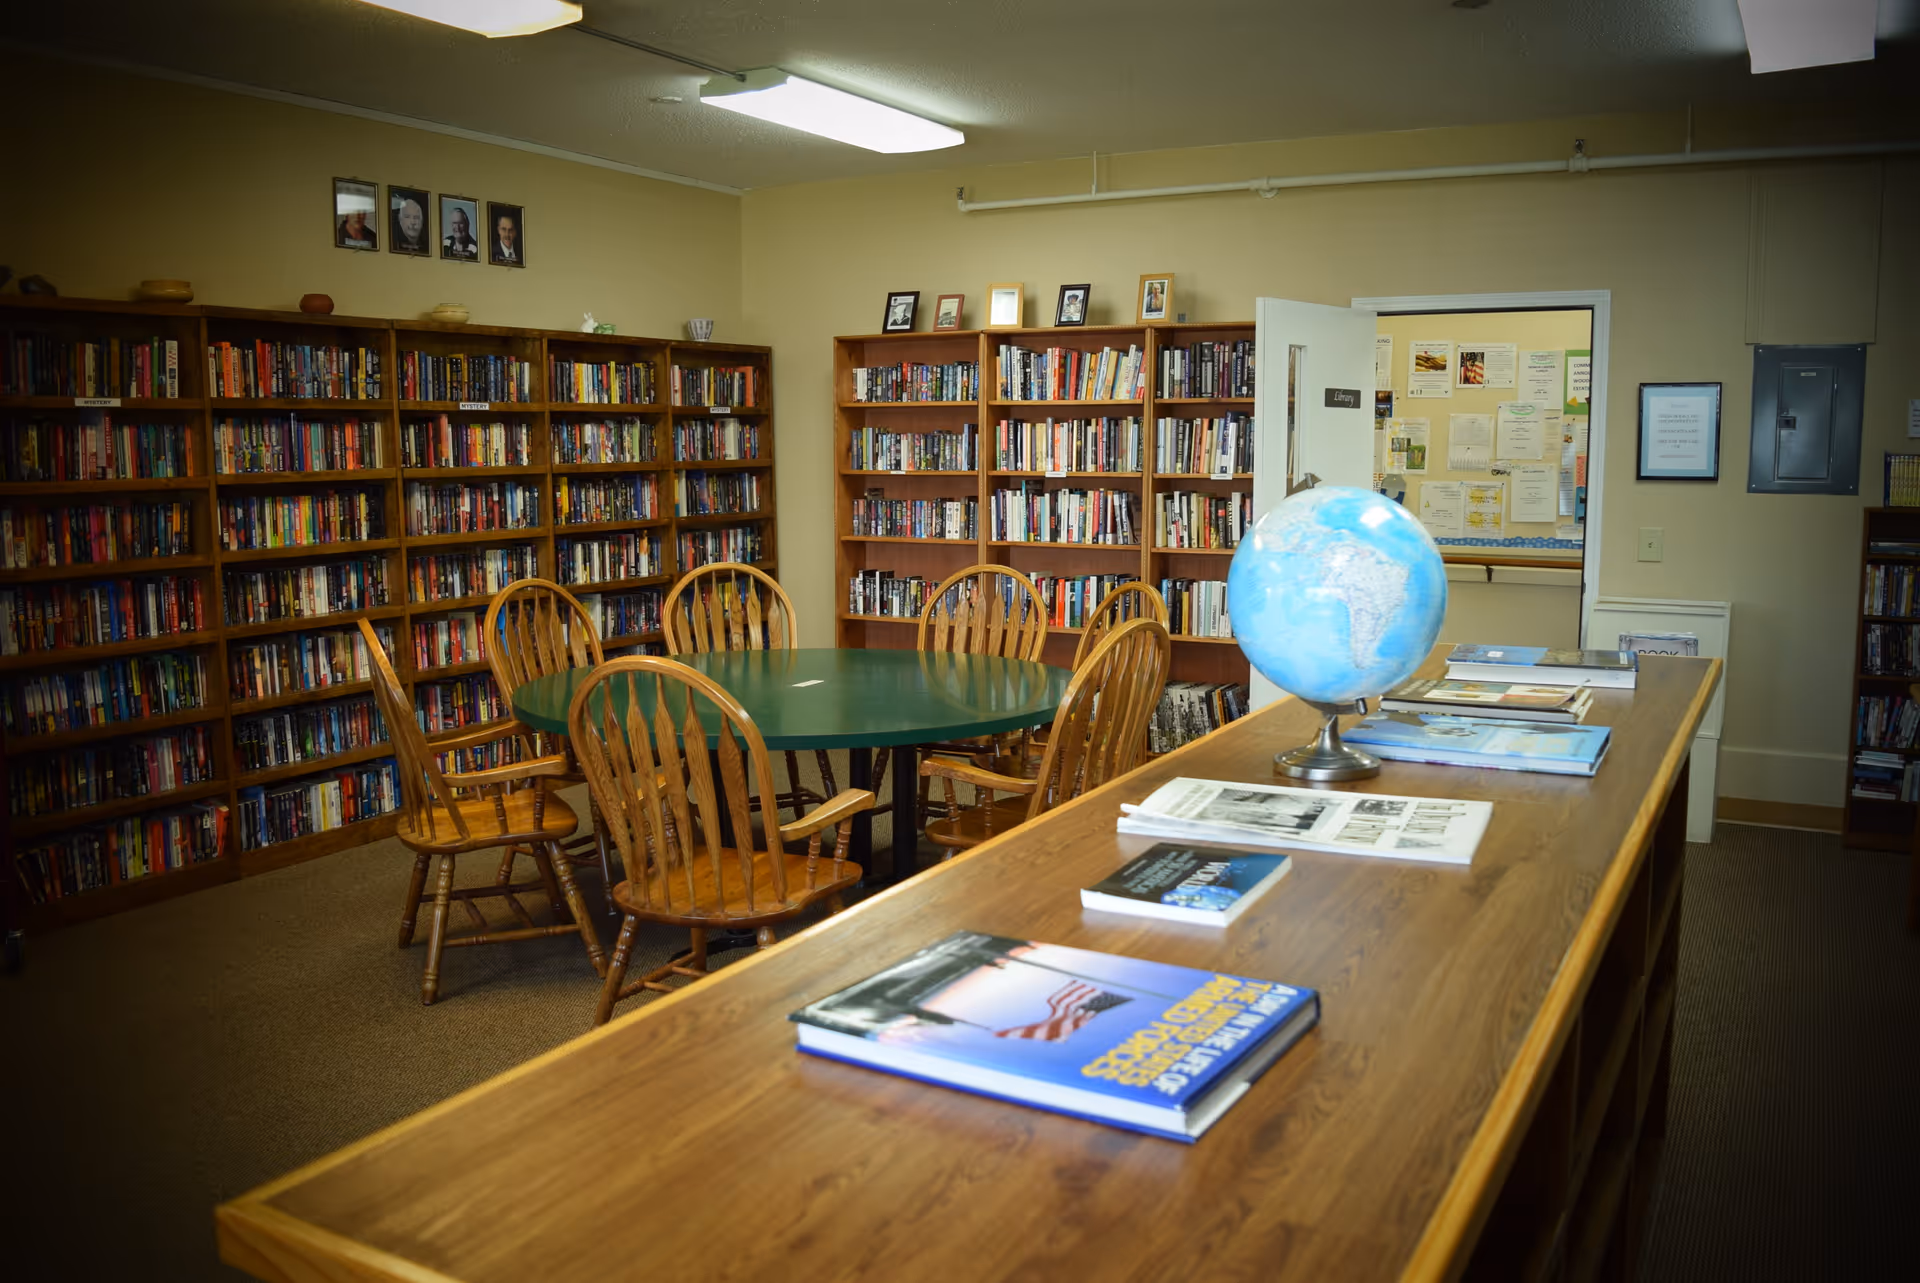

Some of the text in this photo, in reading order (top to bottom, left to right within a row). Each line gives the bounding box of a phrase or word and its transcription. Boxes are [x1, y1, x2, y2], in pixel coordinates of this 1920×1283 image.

[1334, 390, 1354, 408] Library
[1080, 974, 1243, 1080] ARMED FORCES
[1118, 980, 1273, 1088] THE UNITED STATES
[1152, 983, 1298, 1096] A DAY IN THE LIFE OF
